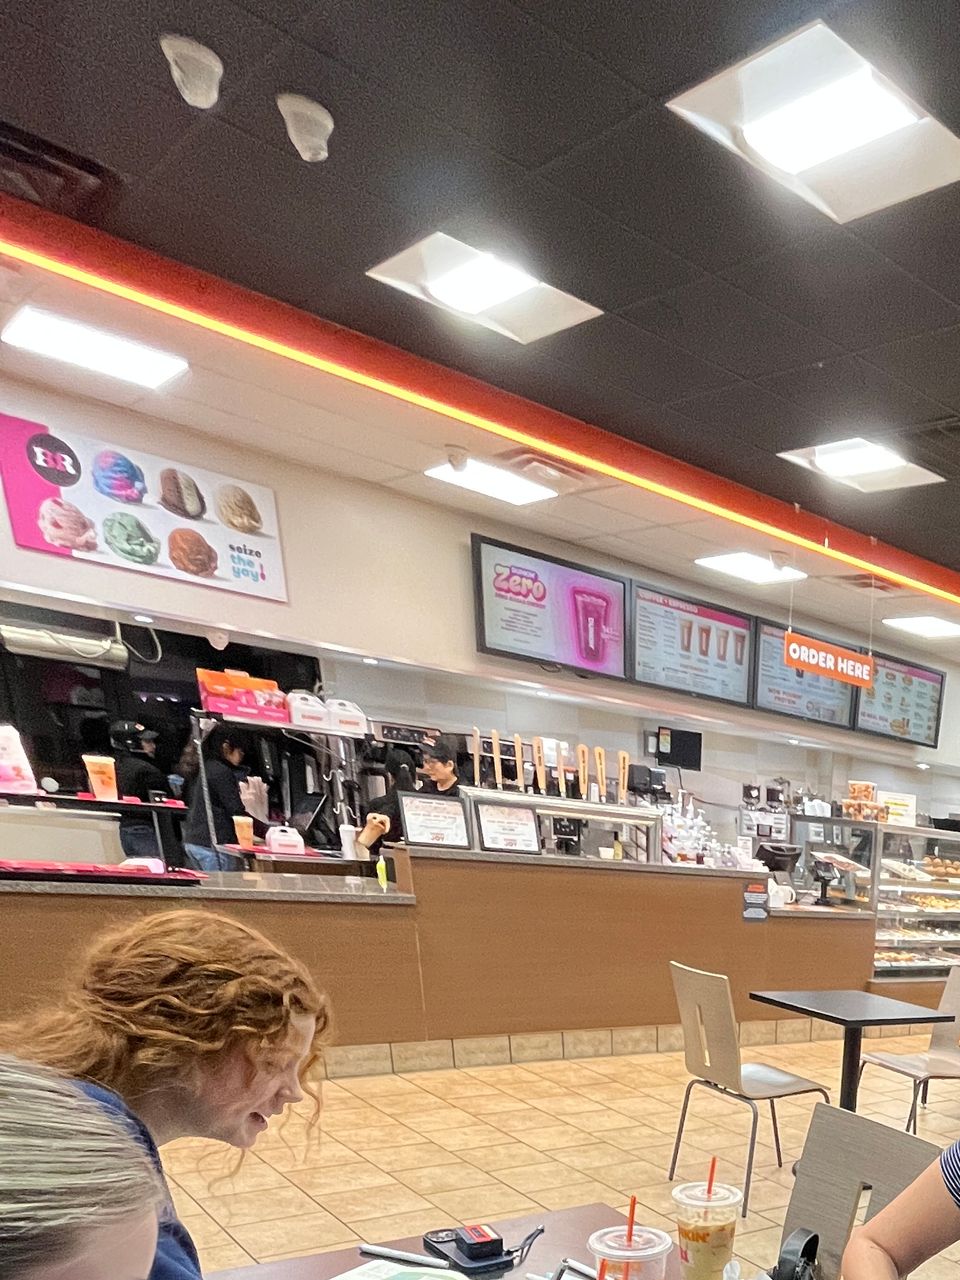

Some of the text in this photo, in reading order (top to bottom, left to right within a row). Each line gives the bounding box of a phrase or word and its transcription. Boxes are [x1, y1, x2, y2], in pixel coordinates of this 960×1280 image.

[231, 554, 256, 569] the
[493, 563, 546, 602] Zero
[789, 643, 834, 671] ORDER
[837, 656, 871, 680] HERE
